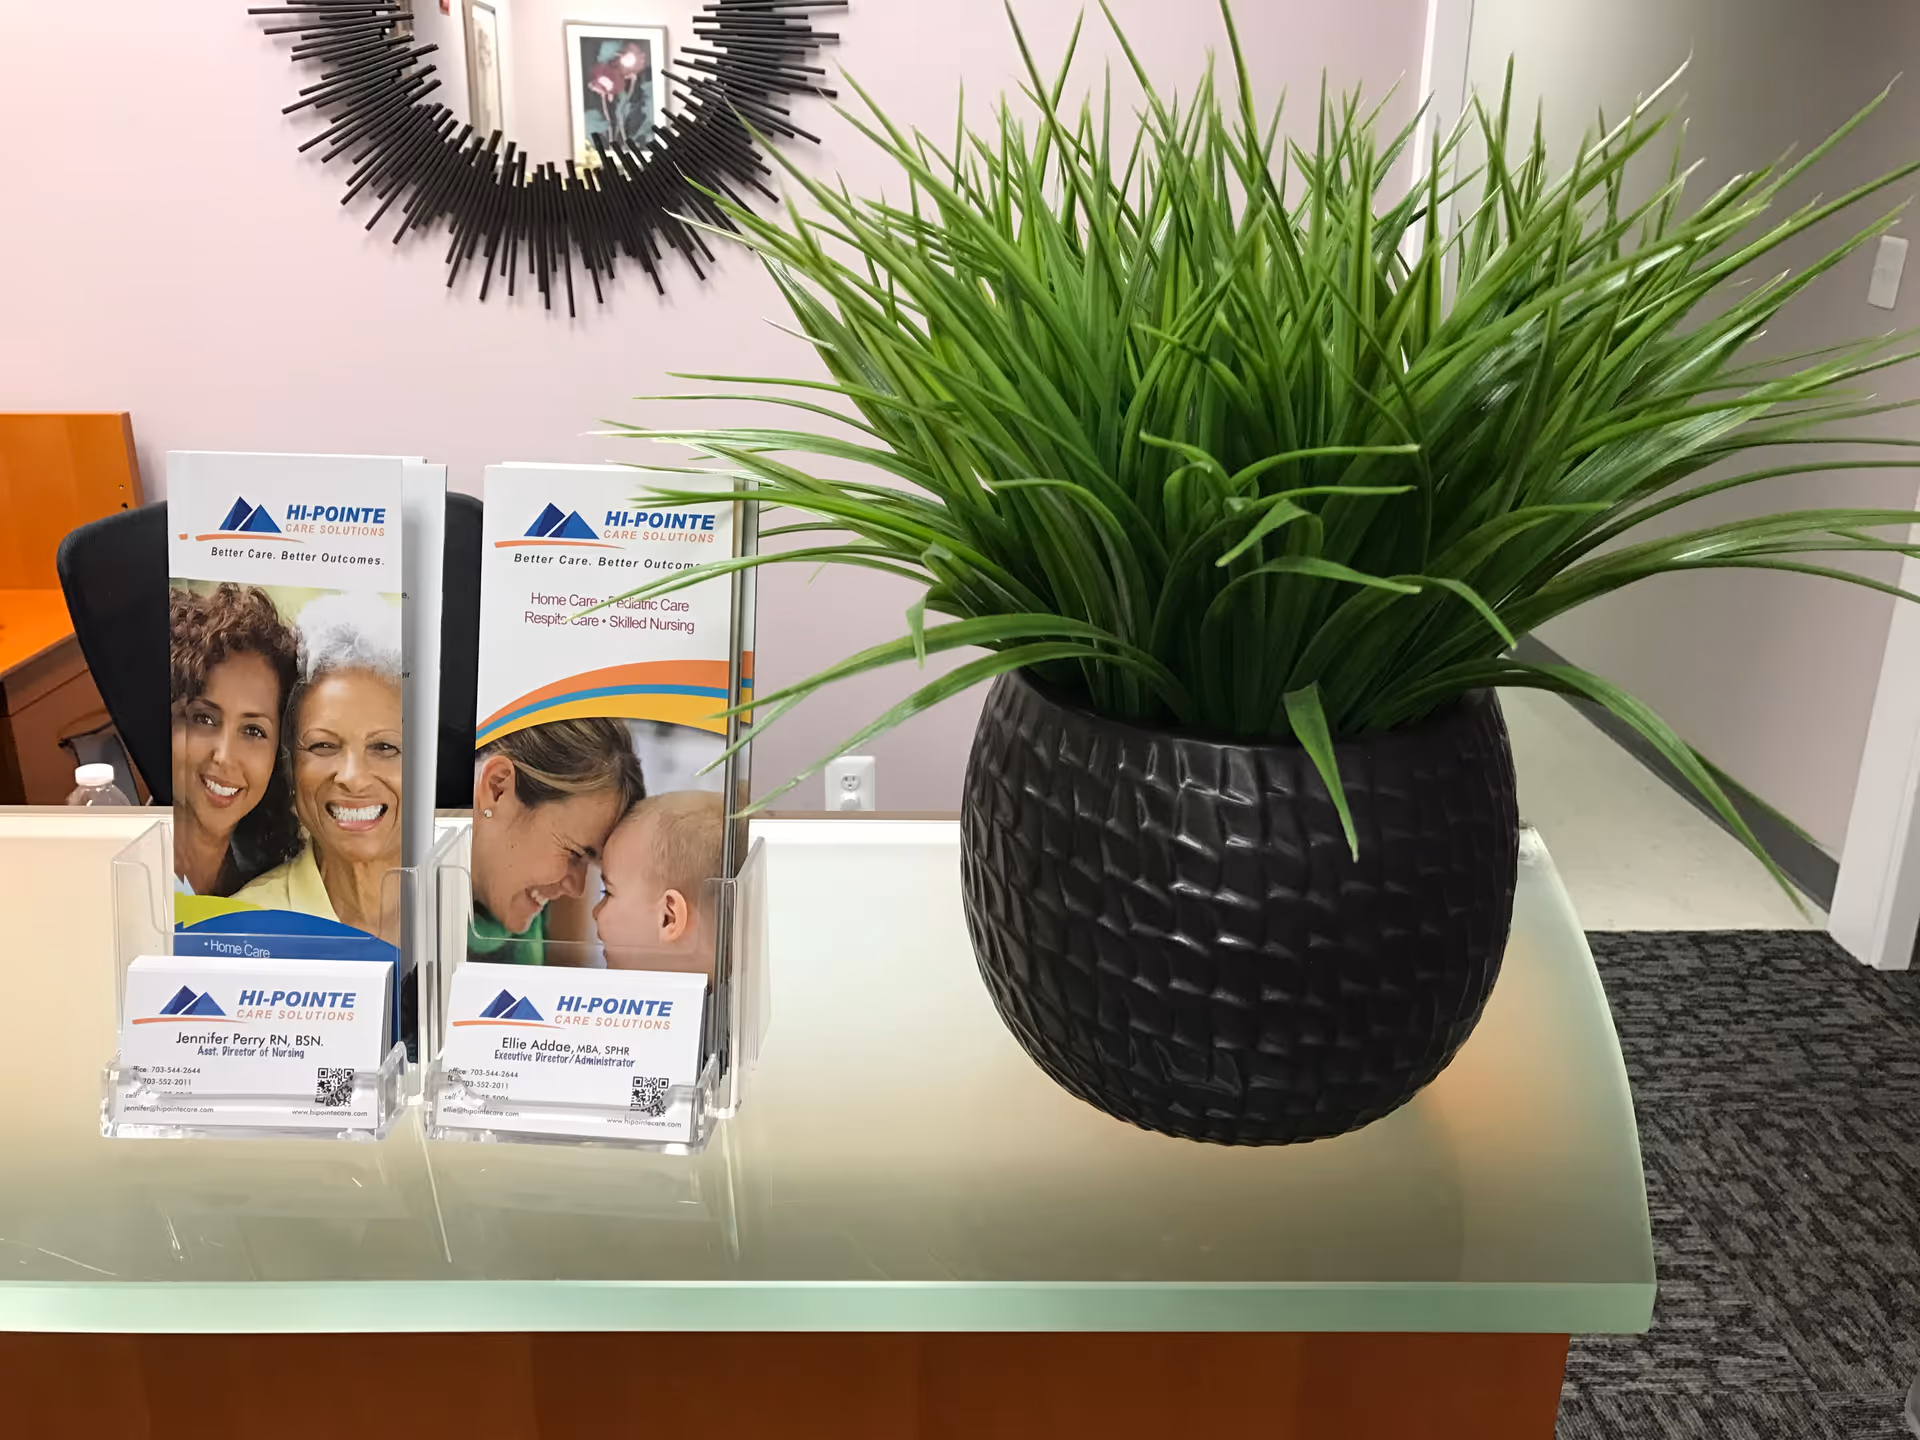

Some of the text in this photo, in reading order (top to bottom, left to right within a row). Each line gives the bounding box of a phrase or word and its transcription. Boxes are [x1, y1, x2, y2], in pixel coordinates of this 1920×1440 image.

[286, 504, 386, 524] HI-POINTE
[605, 511, 715, 531] HI-POINTE
[285, 523, 385, 537] CARE SOLUTIONS
[603, 529, 714, 544] CARE SOLUTIONS
[211, 547, 385, 566] Better Care. Better Outcomes.
[514, 553, 554, 564] Better
[559, 555, 592, 566] Care.
[598, 557, 638, 569] Better
[531, 592, 566, 606] Home
[569, 594, 598, 608] Care
[660, 598, 689, 612] Care
[571, 613, 599, 627] Care
[609, 615, 646, 630] Skilled
[650, 617, 695, 634] Nursing
[210, 939, 270, 958] Home Care
[238, 990, 356, 1009] HI-POINTE
[556, 995, 673, 1017] HI-POINTE
[236, 1009, 354, 1021] CARE SOLUTIONS
[554, 1015, 671, 1030] CARE SOLUTIONS
[175, 1032, 324, 1048] Jennifer Perry RN, BSN.
[502, 1037, 630, 1056] Ellie Addae, MBA, SPHR
[197, 1045, 305, 1059] Asst. Director of Nursing
[494, 1049, 636, 1068] Executive Director/Administrator
[151, 1066, 201, 1074] 703-544-2644
[470, 1069, 519, 1078] 703-544-2644
